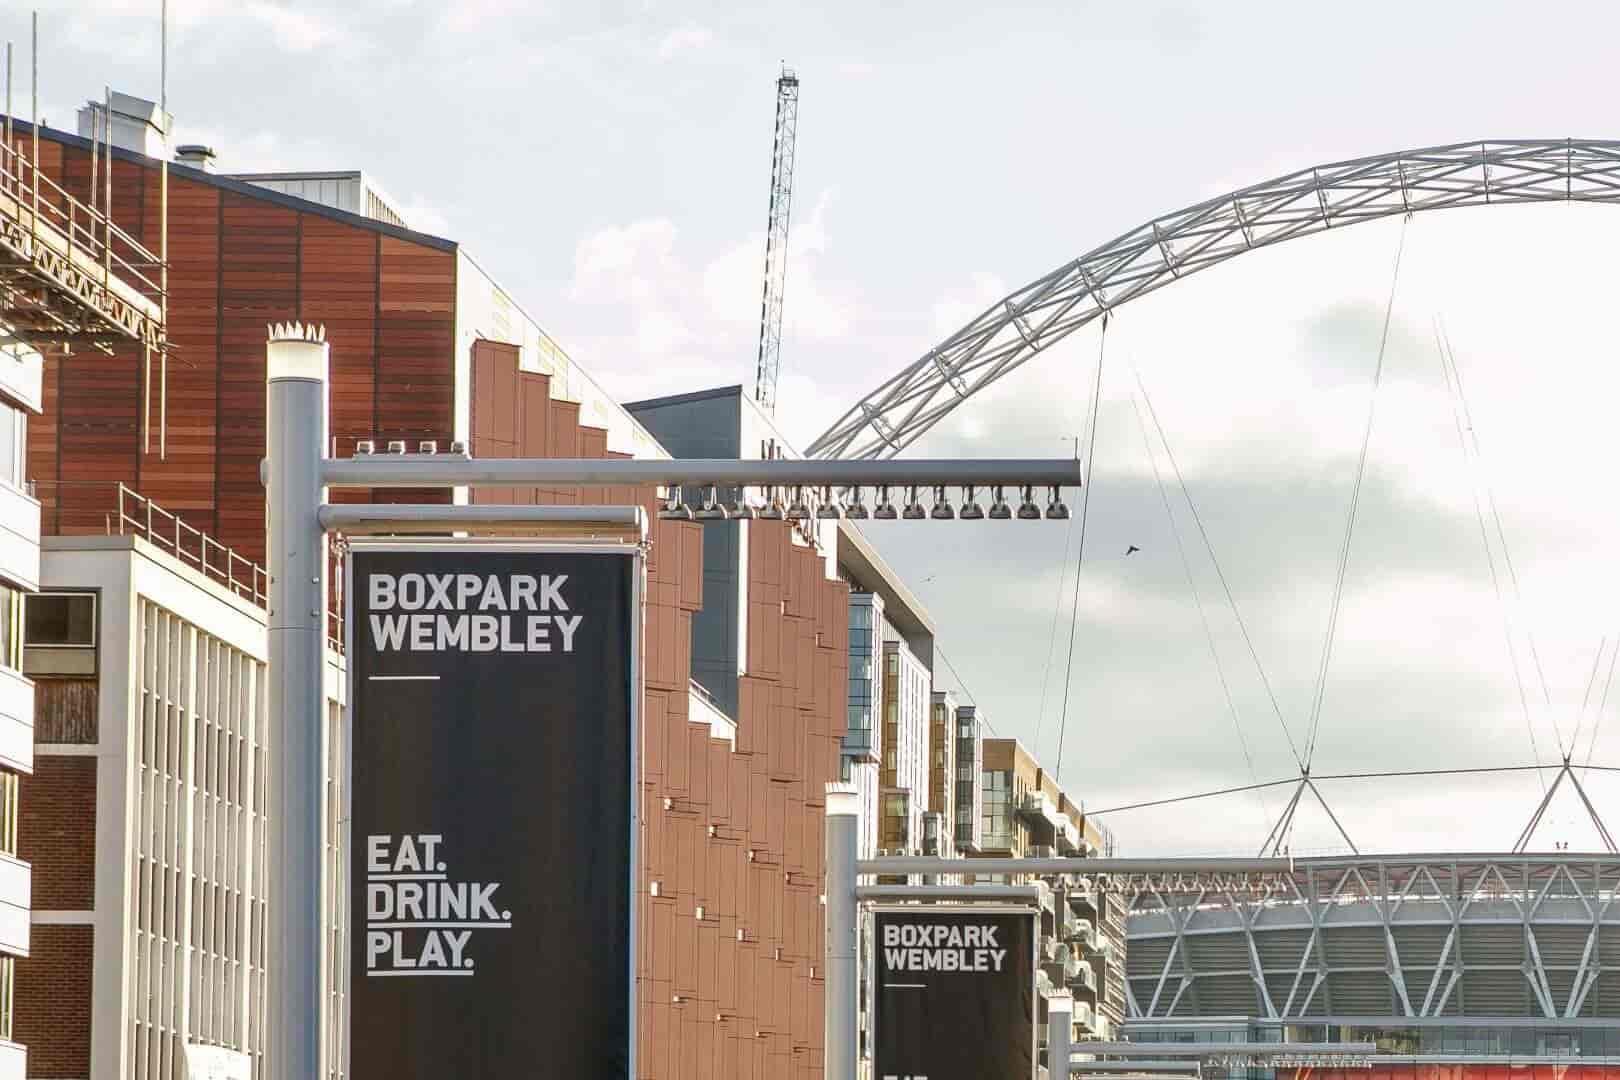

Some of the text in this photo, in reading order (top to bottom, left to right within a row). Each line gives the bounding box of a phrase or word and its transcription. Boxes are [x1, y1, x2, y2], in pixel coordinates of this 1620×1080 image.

[369, 573, 569, 611] BOXPARK
[369, 614, 583, 653] WEMBLEY
[367, 835, 447, 872] EAT.
[367, 882, 512, 921] DRINK.
[367, 930, 474, 969] PLAY.
[884, 924, 999, 948] BOXPARK
[884, 949, 1007, 972] WEMBLEY
